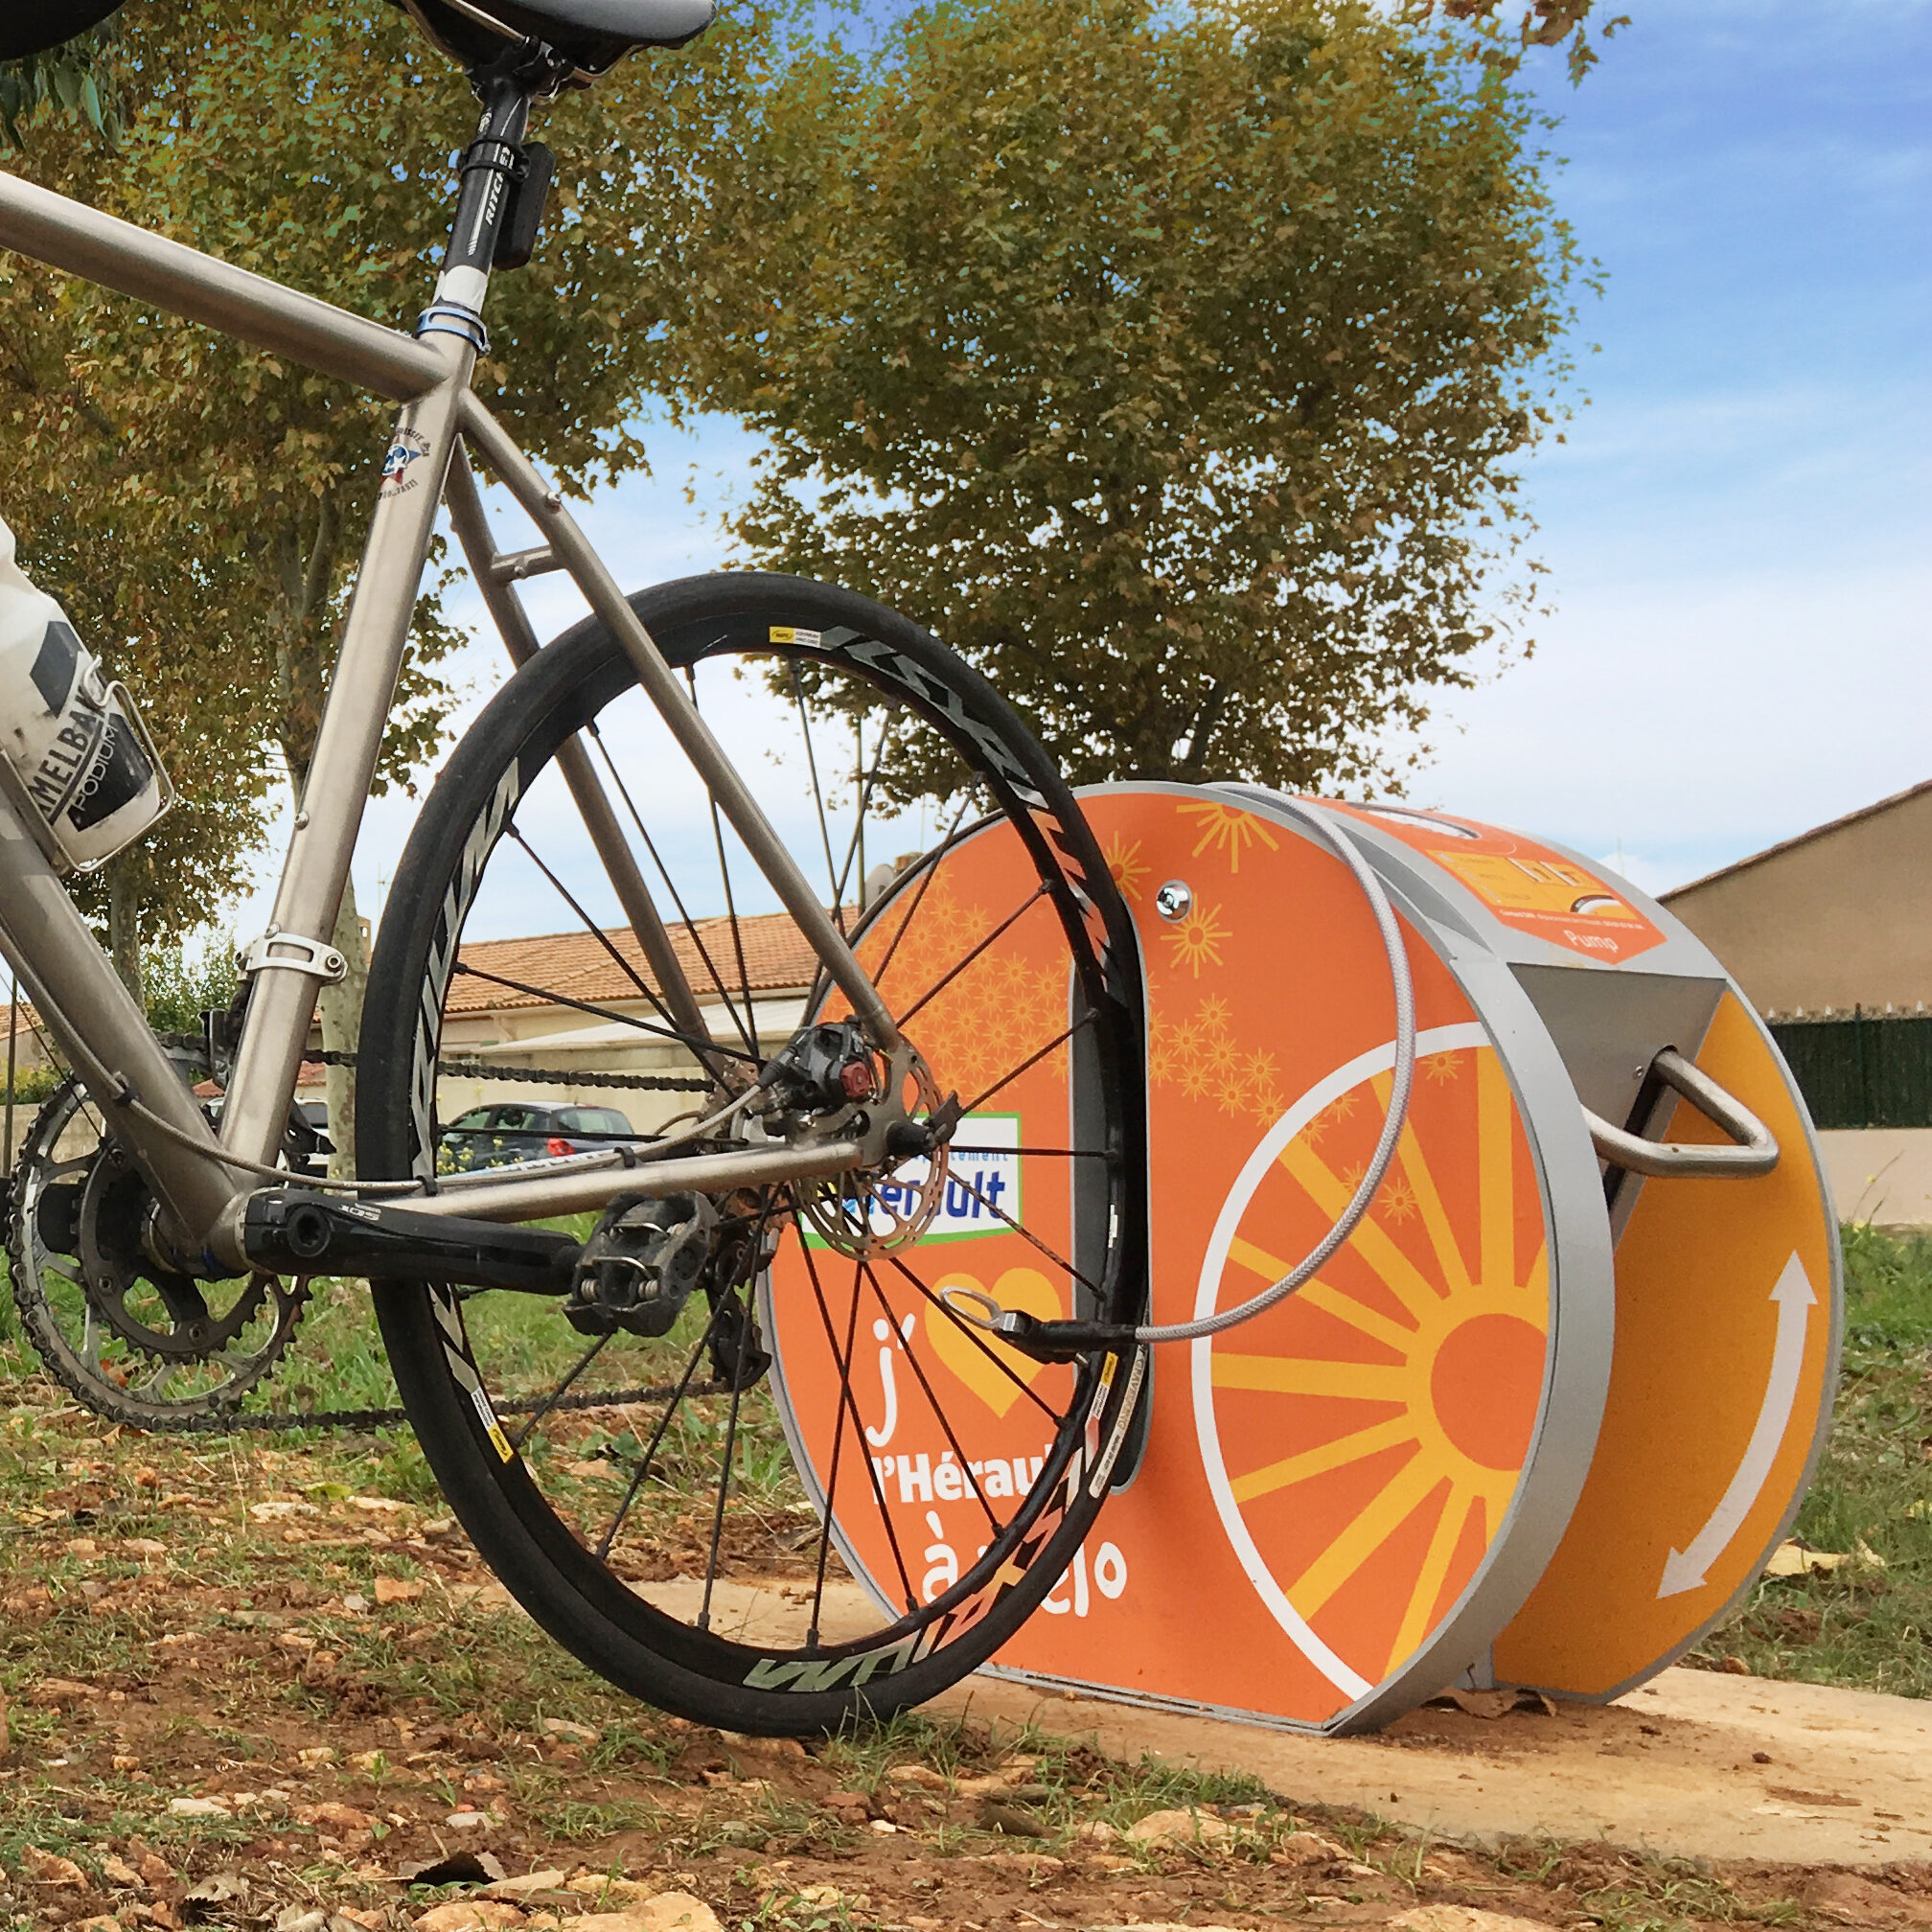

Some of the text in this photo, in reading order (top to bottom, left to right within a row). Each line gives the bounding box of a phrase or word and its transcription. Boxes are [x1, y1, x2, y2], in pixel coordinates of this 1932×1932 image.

[29, 684, 105, 812] MELBAK
[75, 724, 119, 812] PODIUM
[1564, 930, 1620, 954] Pump
[871, 1443, 1054, 1505] l’Hérau
[922, 1510, 959, 1604] à
[977, 1541, 1128, 1618] lo
